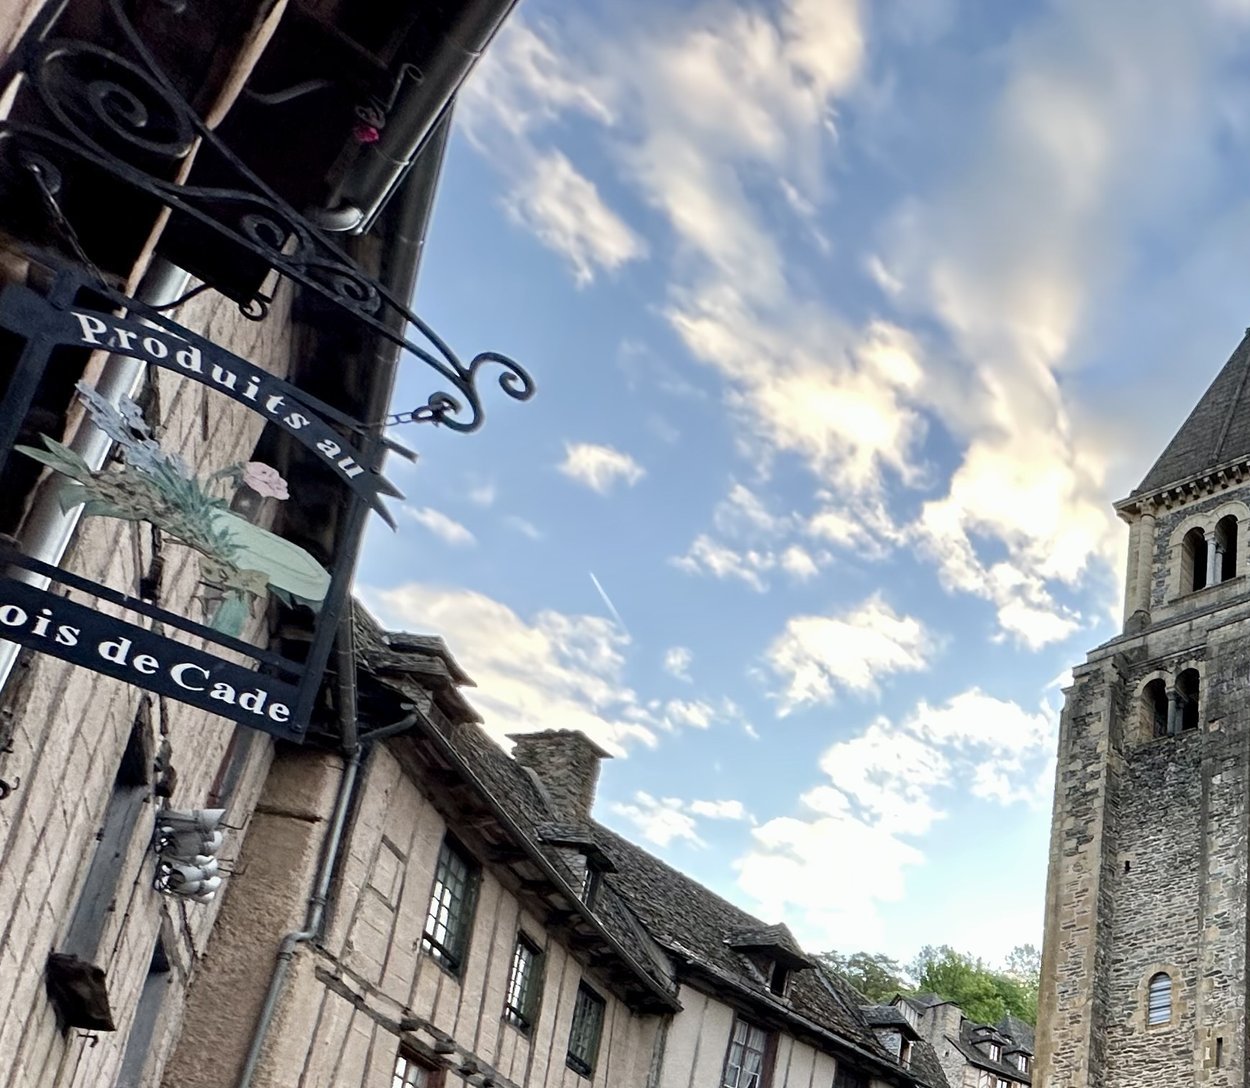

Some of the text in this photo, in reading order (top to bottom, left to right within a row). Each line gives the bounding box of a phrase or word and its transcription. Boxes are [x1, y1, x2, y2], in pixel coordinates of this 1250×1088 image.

[70, 311, 365, 480] Produits au
[98, 636, 160, 675] de
[170, 662, 290, 722] Cade
